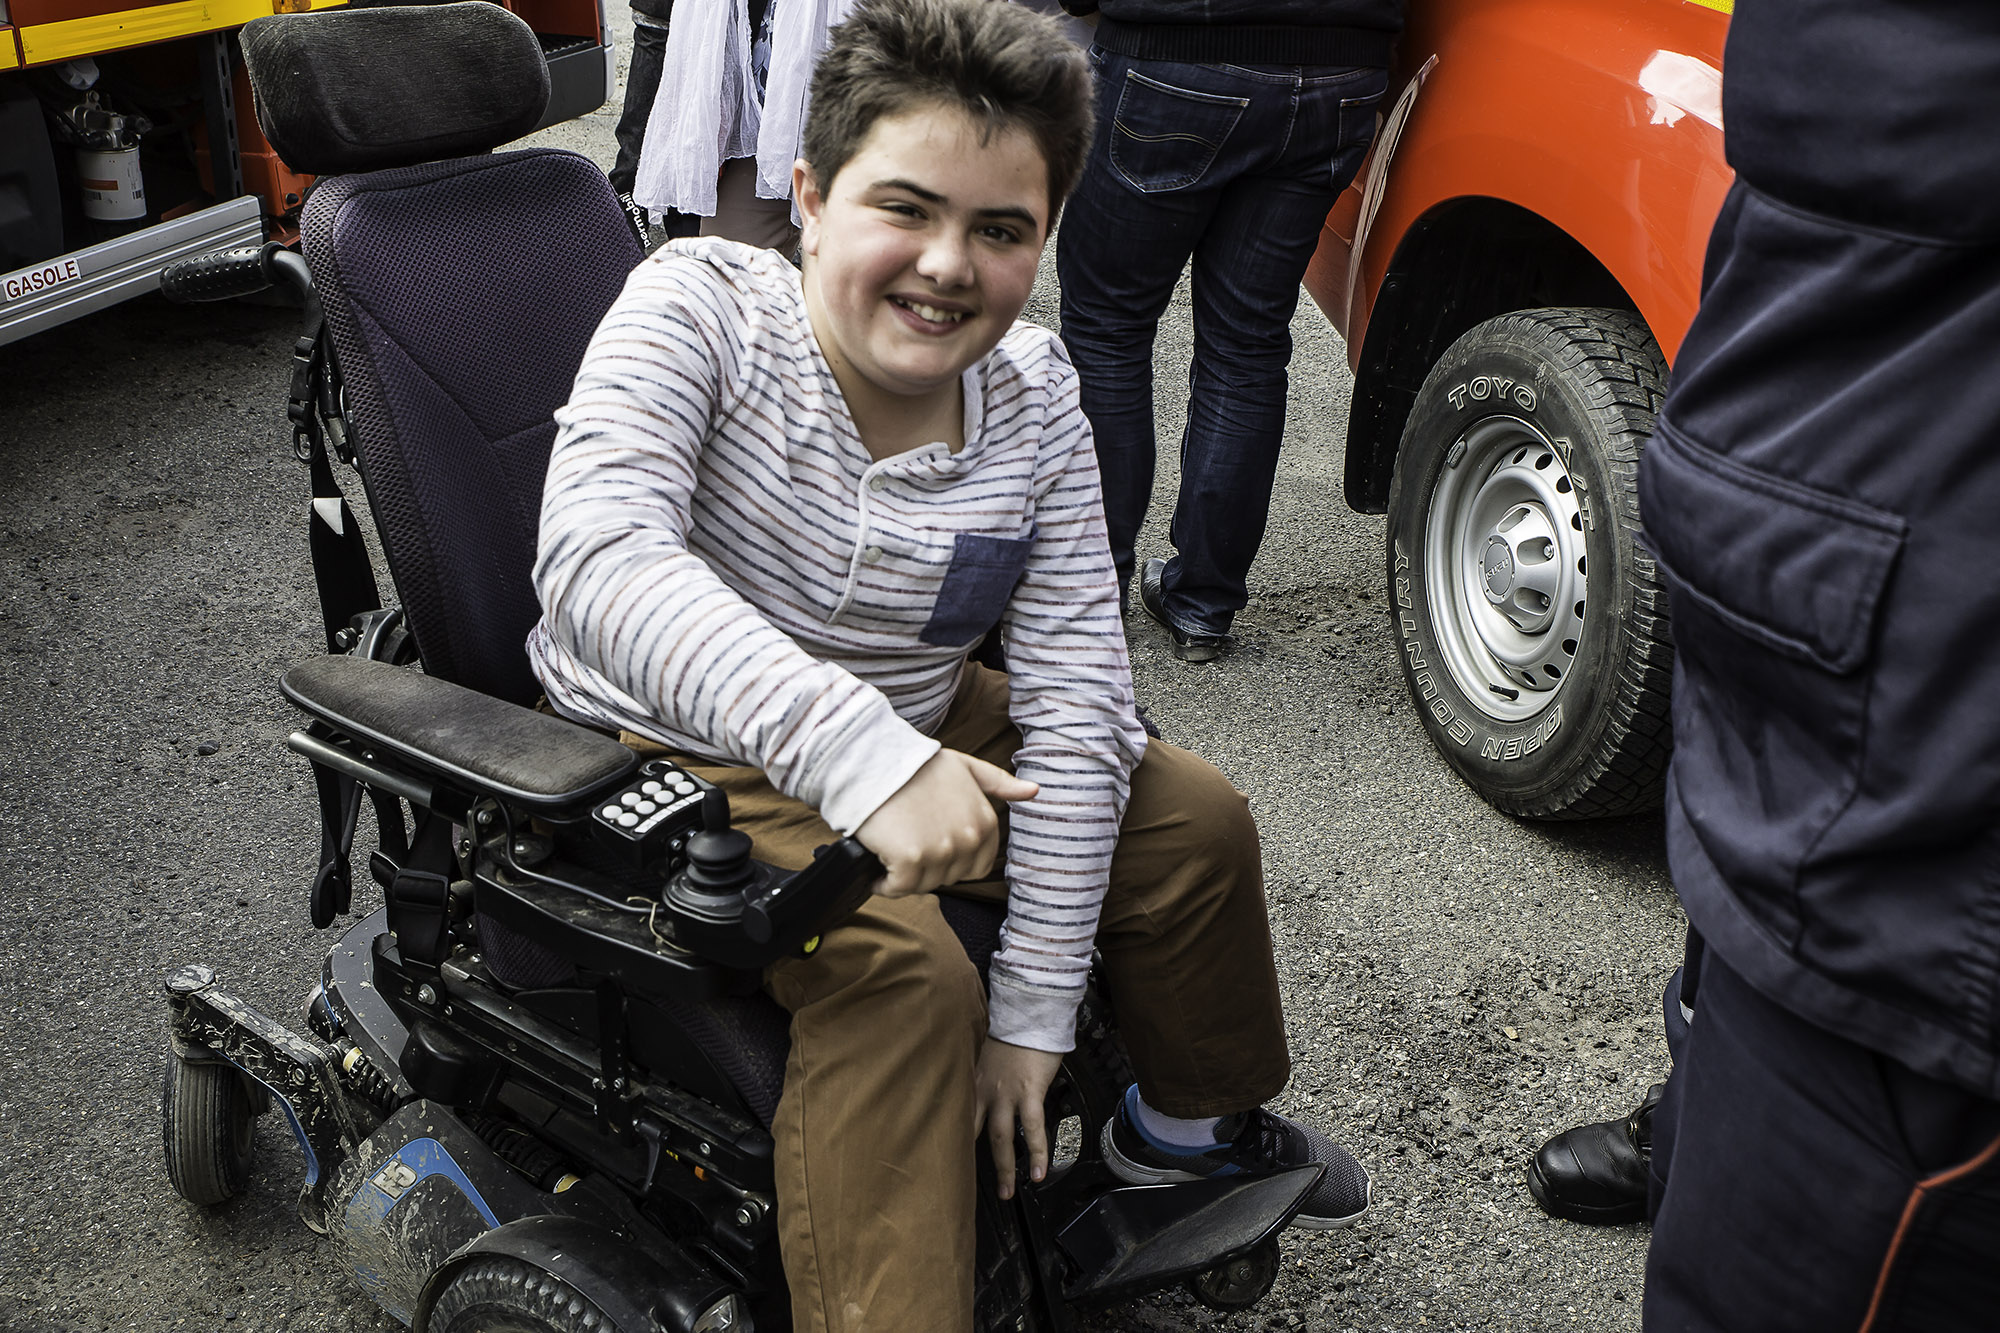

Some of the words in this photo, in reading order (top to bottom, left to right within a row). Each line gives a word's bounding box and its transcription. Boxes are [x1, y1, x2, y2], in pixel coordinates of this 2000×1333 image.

[619, 192, 652, 248] permobil
[6, 260, 78, 298] GASOLE
[1447, 376, 1537, 412] TOYO
[1485, 558, 1509, 581] ISUZU
[1395, 538, 1475, 746] COUNTRY
[1481, 703, 1563, 761] OPEN
